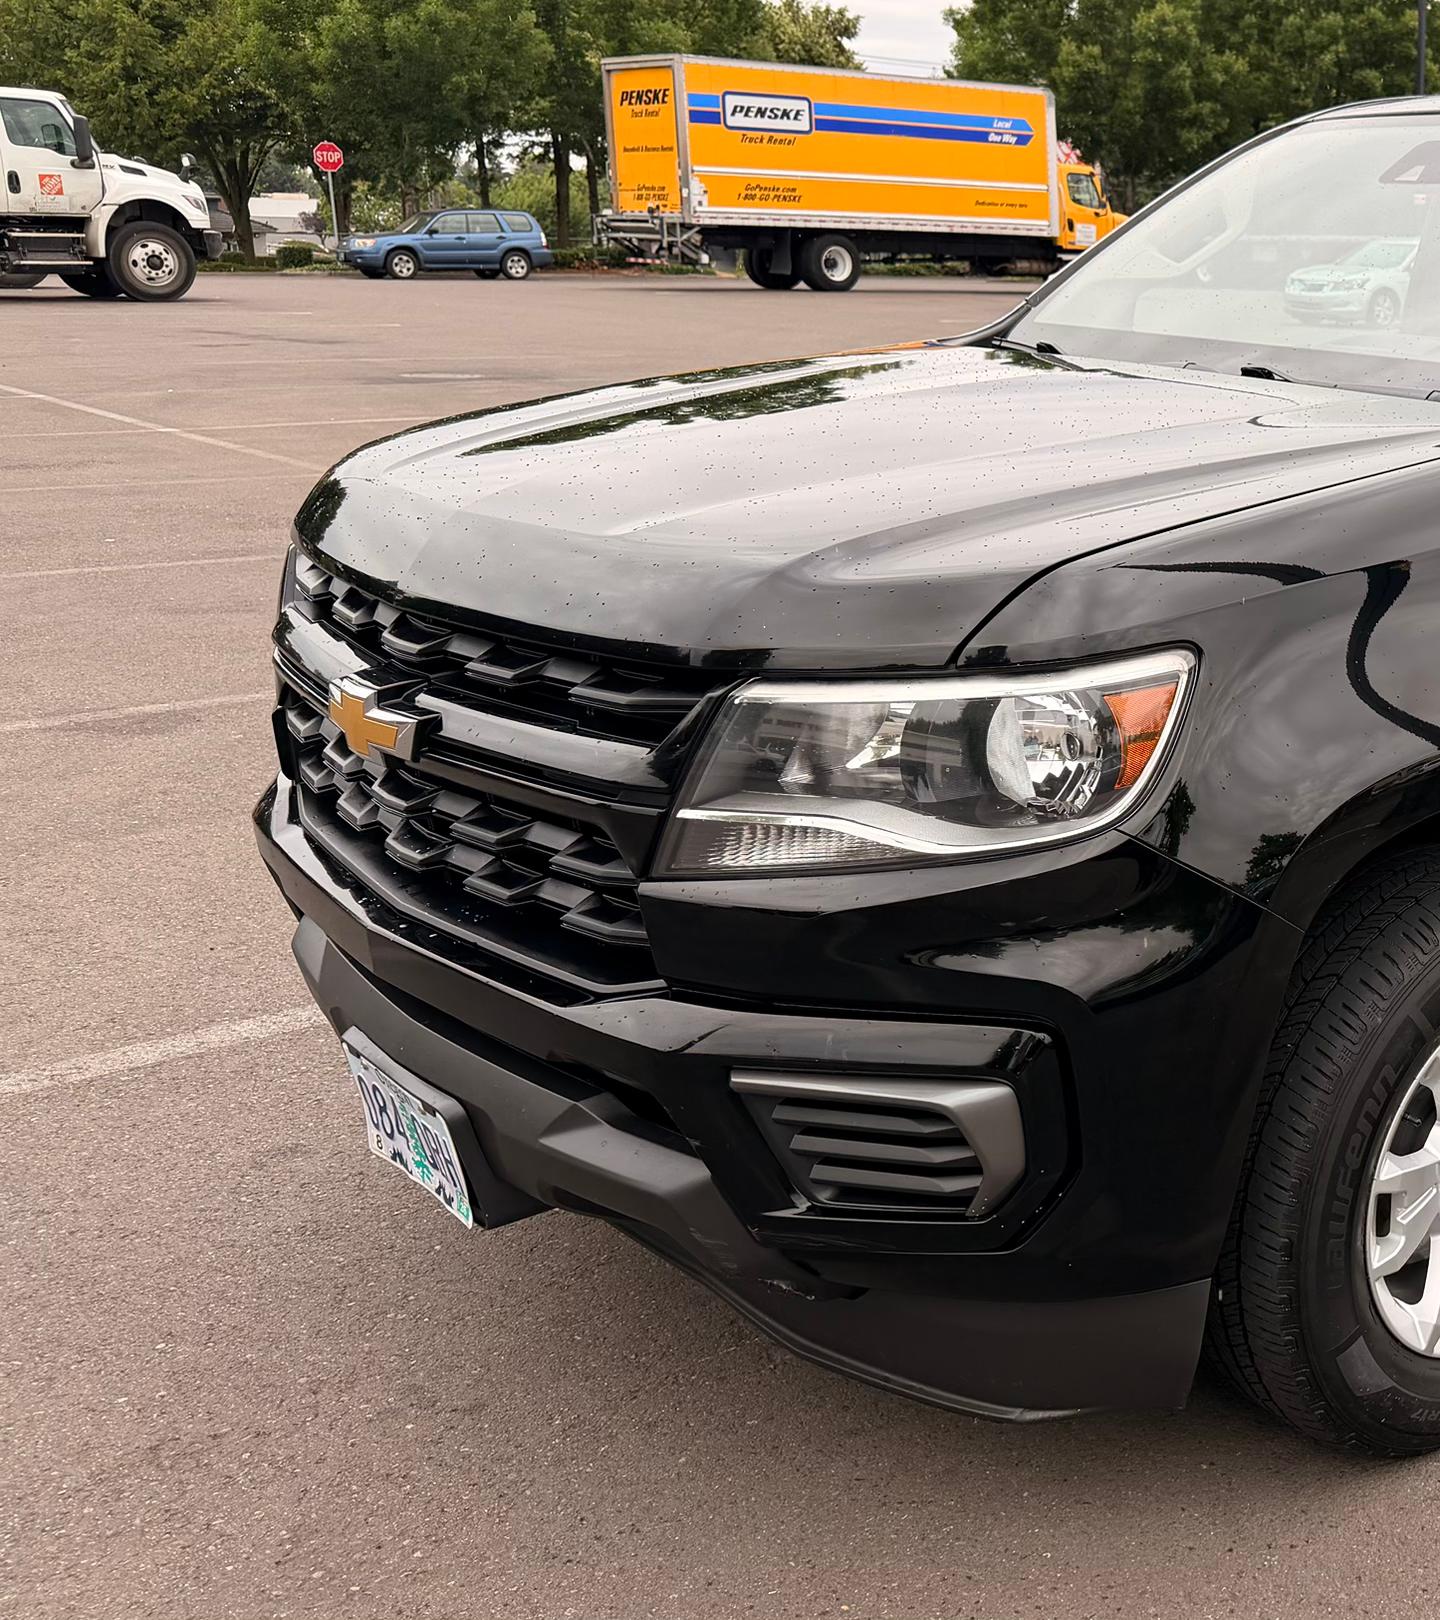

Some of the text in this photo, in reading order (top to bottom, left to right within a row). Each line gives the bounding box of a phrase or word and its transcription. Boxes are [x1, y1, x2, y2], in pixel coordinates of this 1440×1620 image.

[620, 88, 670, 106] PENSKE
[730, 104, 806, 122] PENSKE
[992, 119, 1012, 129] Local
[740, 134, 797, 147] Truck Rental
[988, 132, 1018, 145] One Way
[316, 151, 341, 163] STOP
[744, 183, 797, 194] GoPenske.com
[376, 1134, 383, 1150] 8
